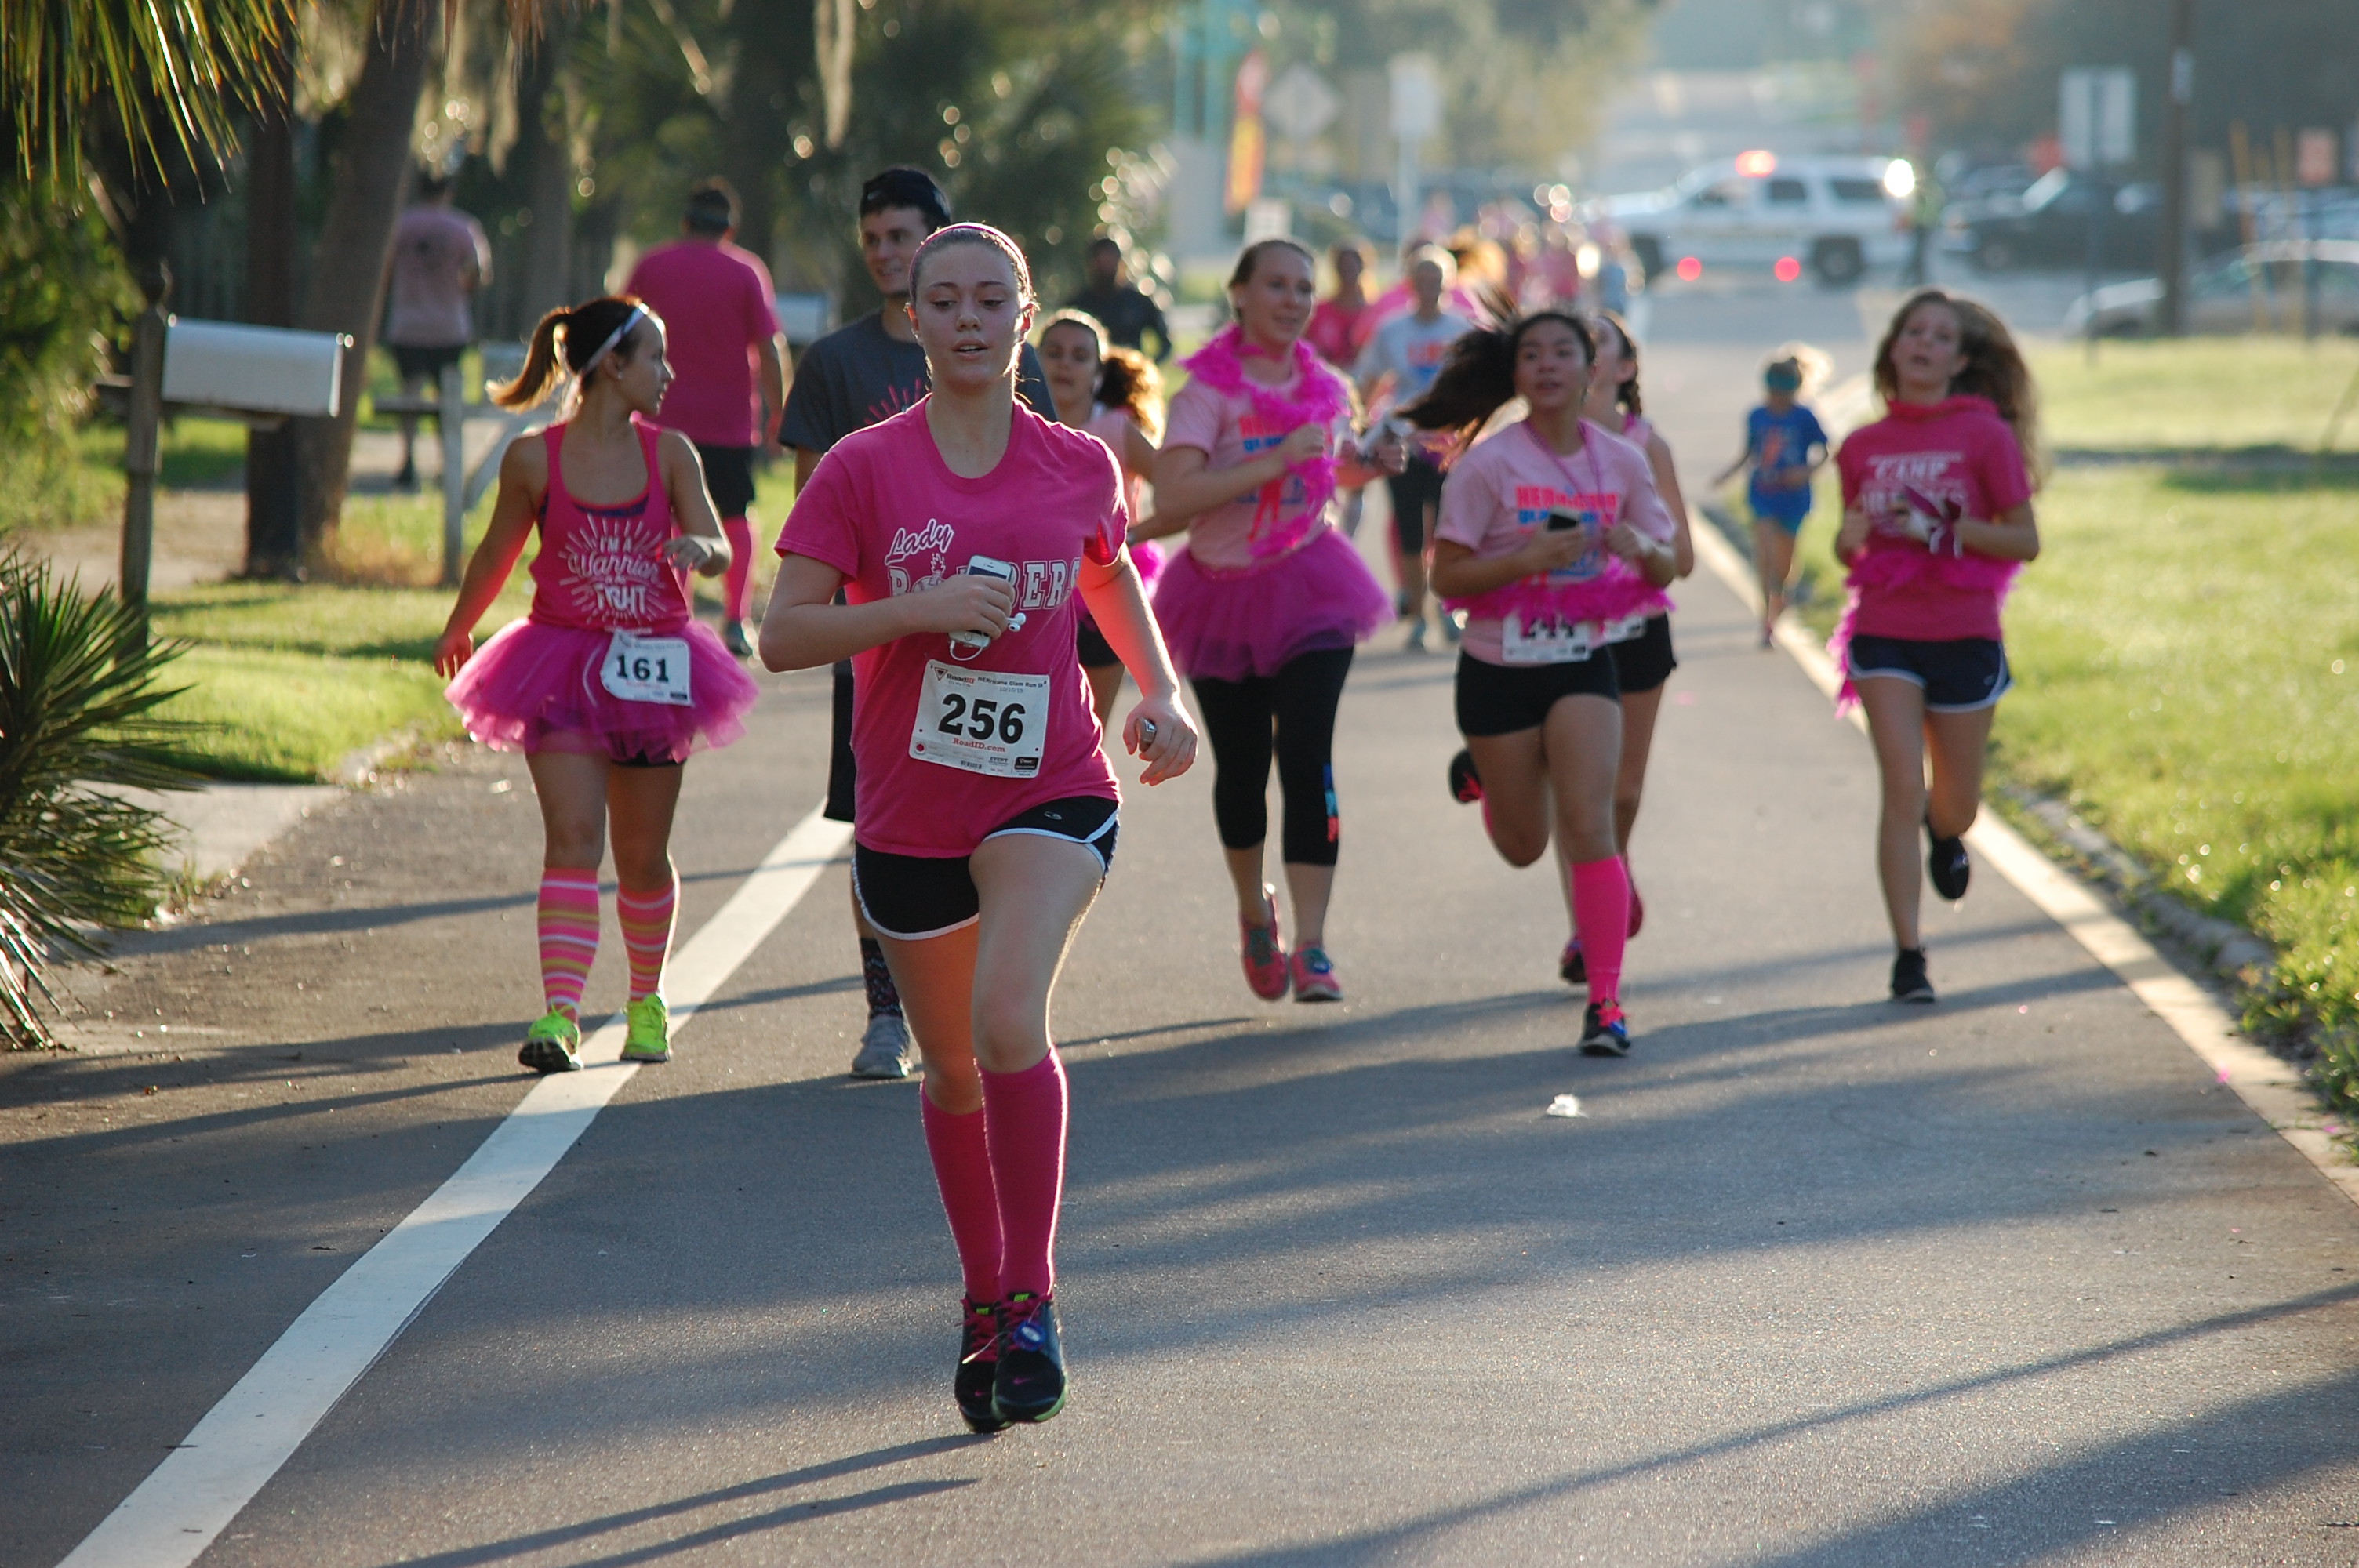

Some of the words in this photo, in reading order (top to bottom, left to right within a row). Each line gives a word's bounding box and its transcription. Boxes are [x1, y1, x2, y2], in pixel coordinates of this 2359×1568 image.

[623, 535, 632, 554] A
[885, 518, 954, 566] Lady
[567, 550, 660, 585] Warrior
[616, 654, 669, 684] 161
[938, 693, 1027, 745] 256
[952, 737, 1006, 753] RoadID.com
